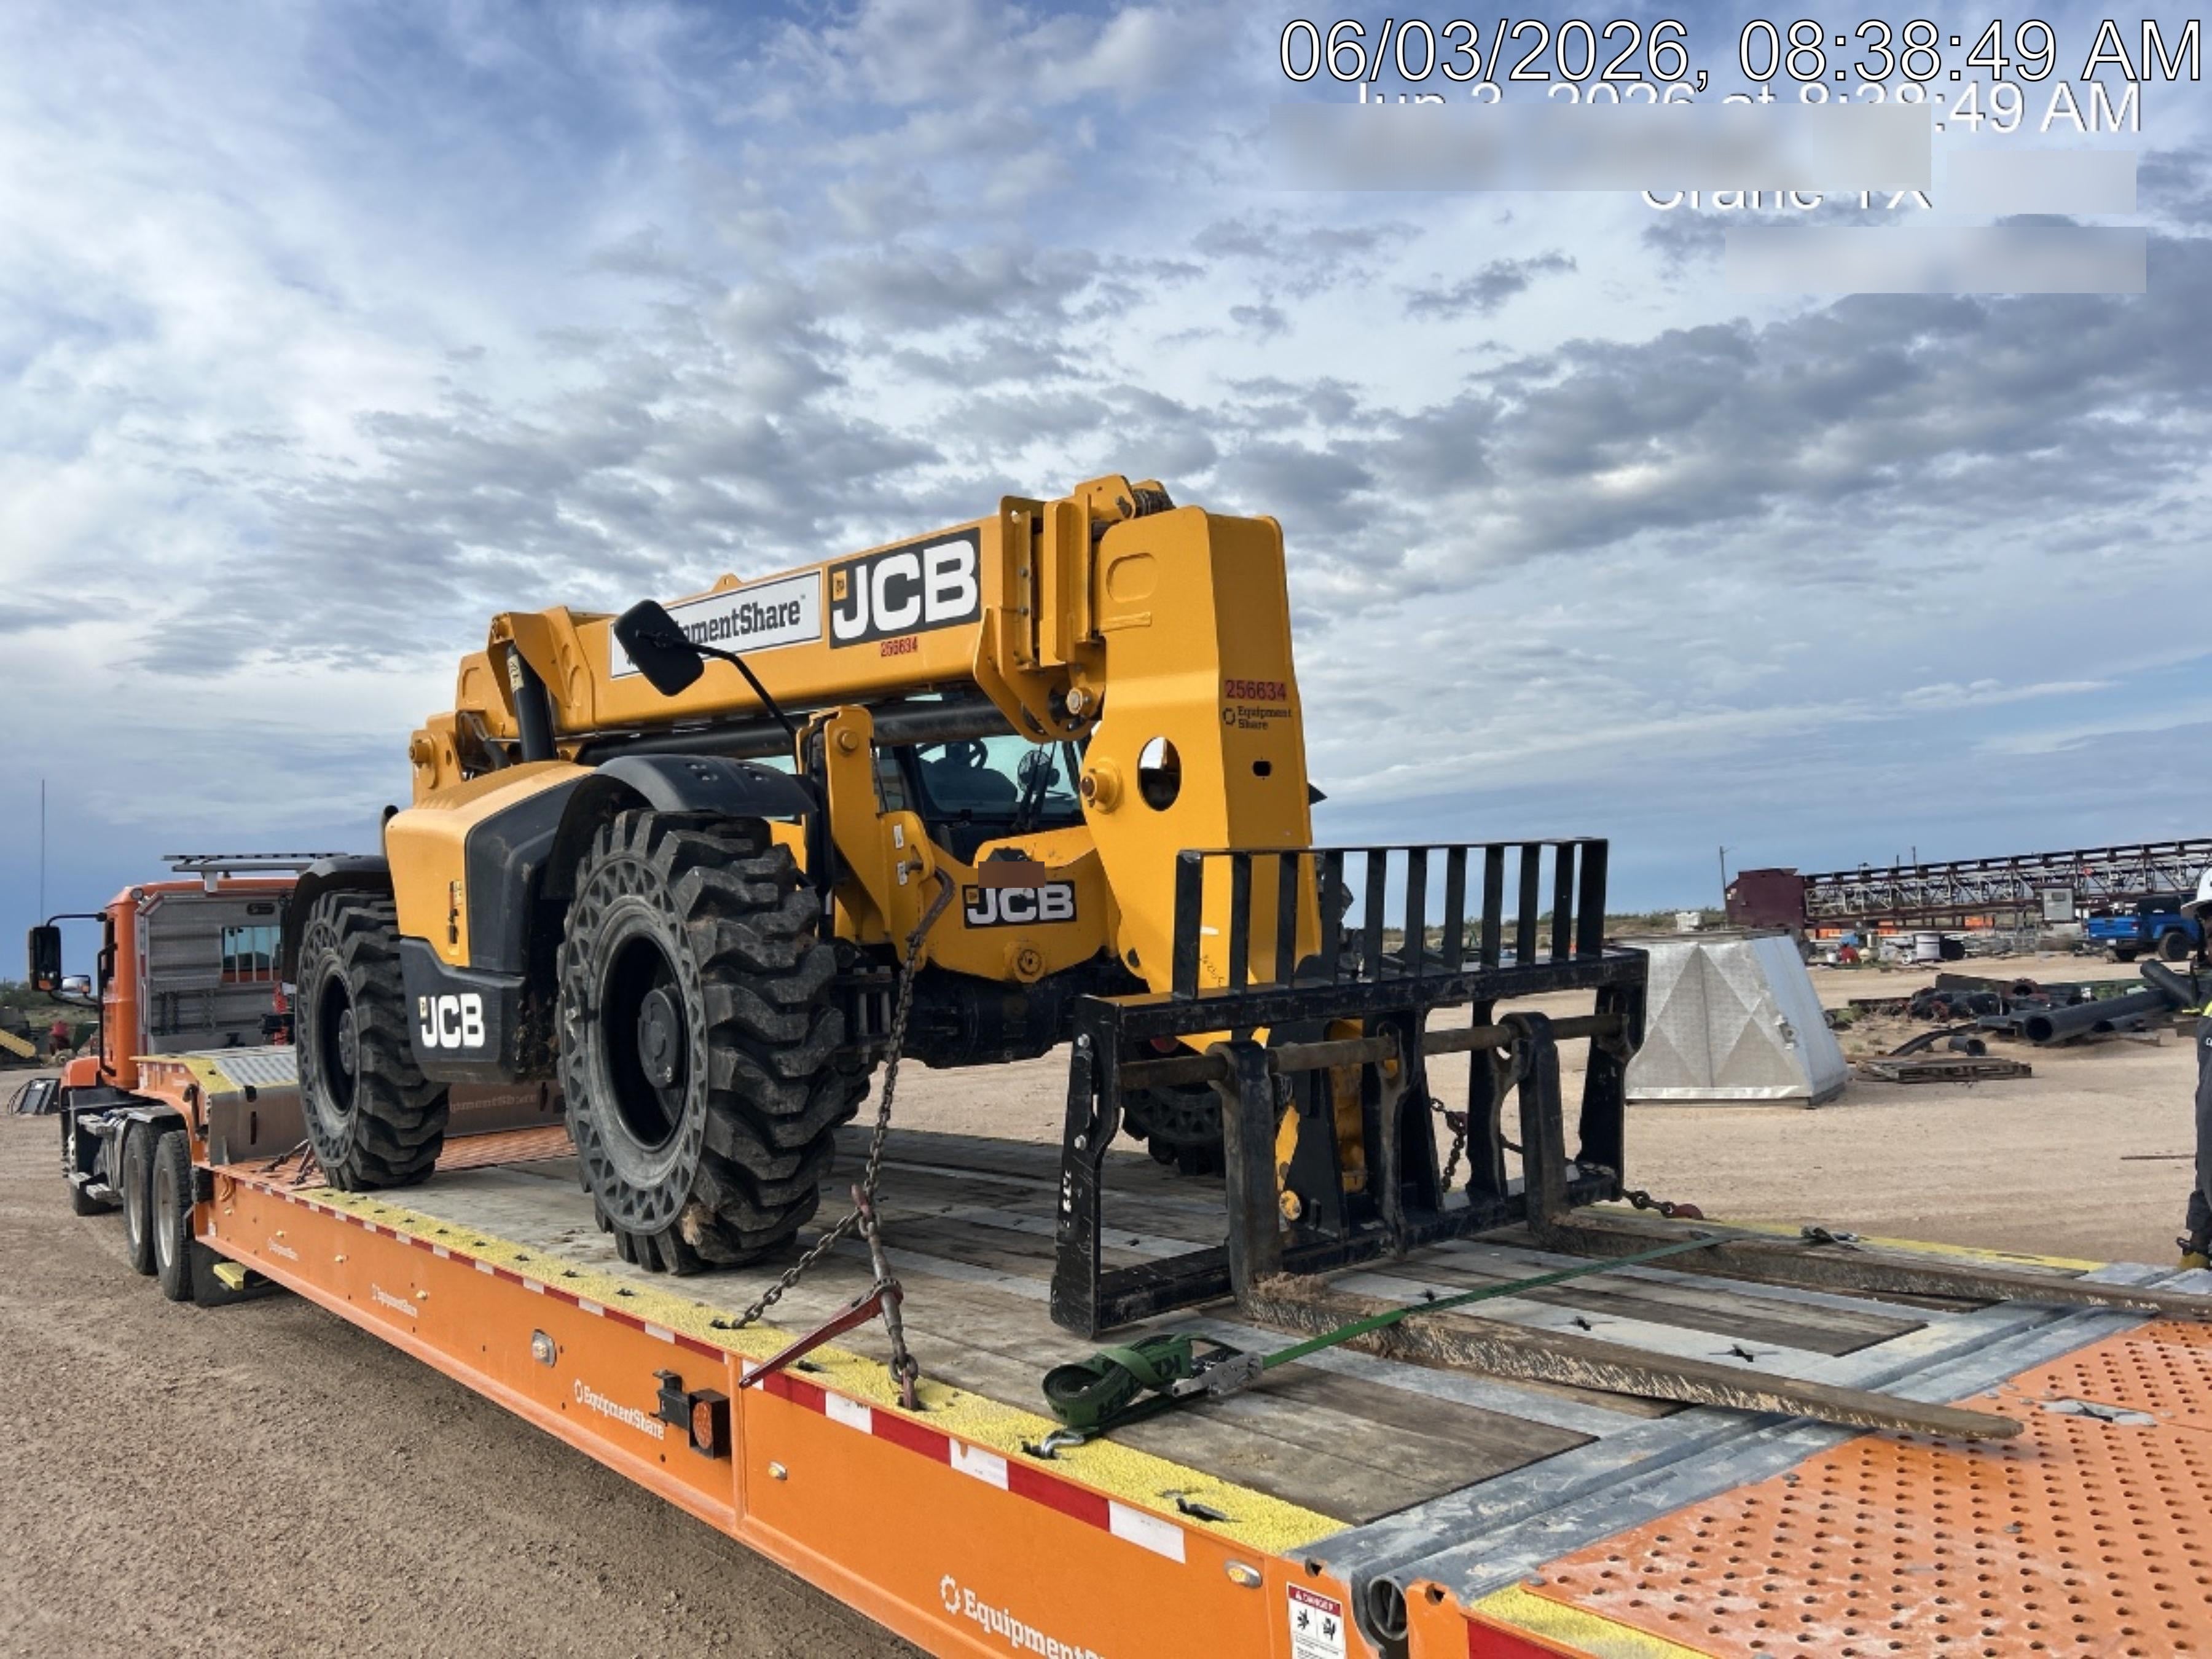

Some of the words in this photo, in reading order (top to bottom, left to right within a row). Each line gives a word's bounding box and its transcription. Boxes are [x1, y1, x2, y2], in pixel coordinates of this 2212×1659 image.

[833, 539, 978, 640] JCB
[881, 637, 917, 657] 256634
[1225, 680, 1287, 701] 256634
[1237, 706, 1292, 720] Equipment
[1237, 719, 1269, 730] Share
[967, 884, 1074, 924] JCB
[421, 993, 485, 1048] JCB
[583, 1385, 665, 1441] EquipmentShare
